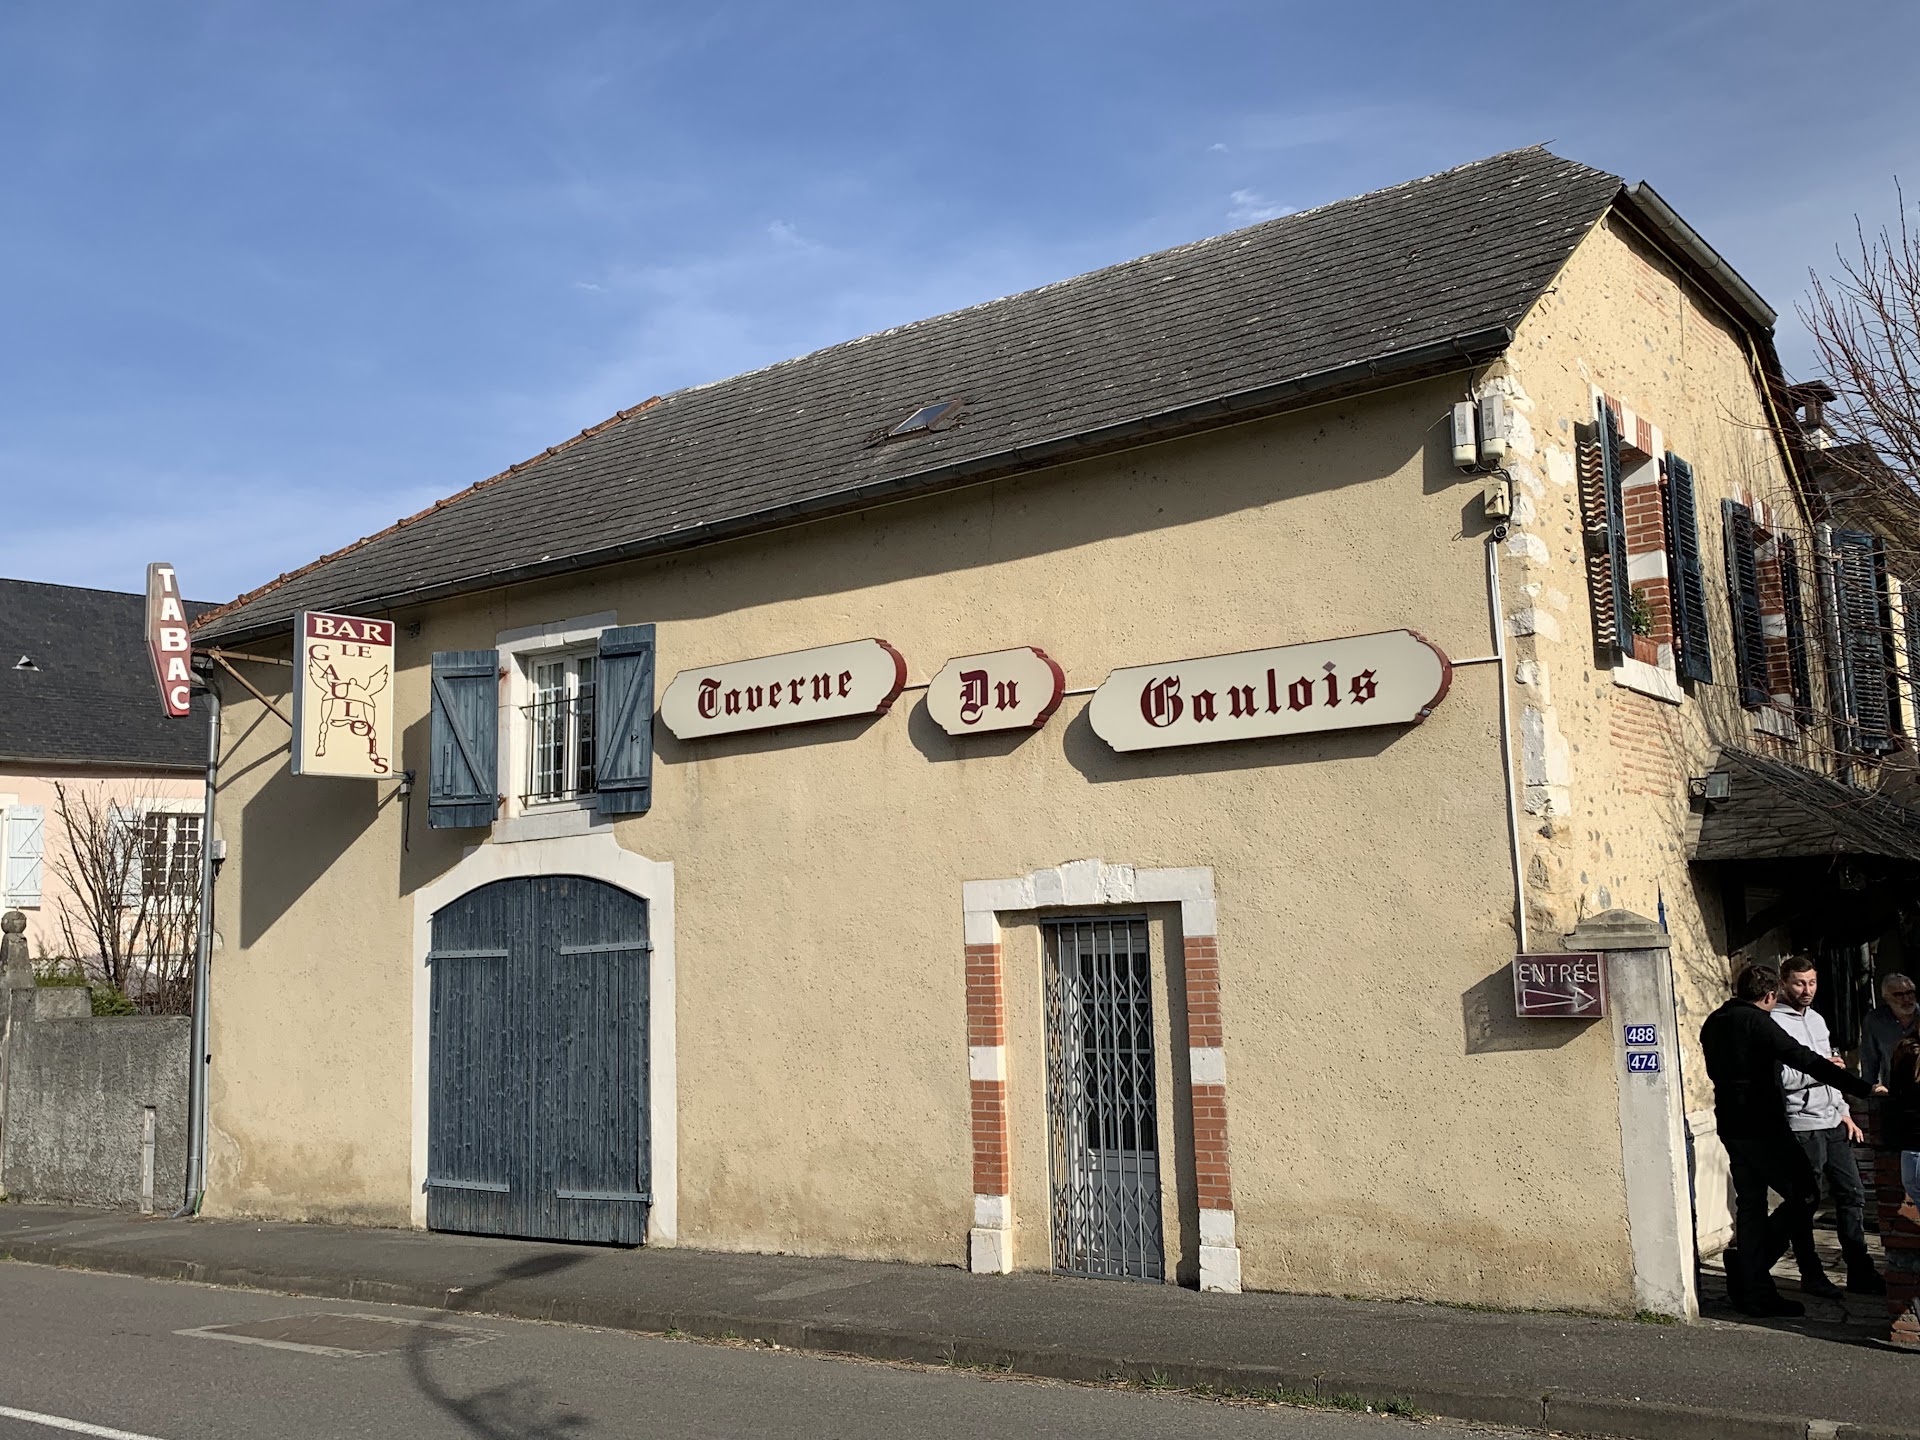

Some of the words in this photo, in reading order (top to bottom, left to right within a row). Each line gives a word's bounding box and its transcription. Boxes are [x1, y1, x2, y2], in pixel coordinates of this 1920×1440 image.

[157, 568, 190, 710] TABAC
[313, 617, 385, 642] BAR
[341, 644, 372, 659] LE
[698, 669, 853, 719] Taverne
[960, 669, 1021, 725] Du
[1140, 661, 1379, 728] Gaulois
[308, 644, 389, 774] GAULOIS
[1518, 958, 1599, 983] ENTRÉE
[1628, 1028, 1654, 1042] 488
[1631, 1055, 1657, 1069] 474
